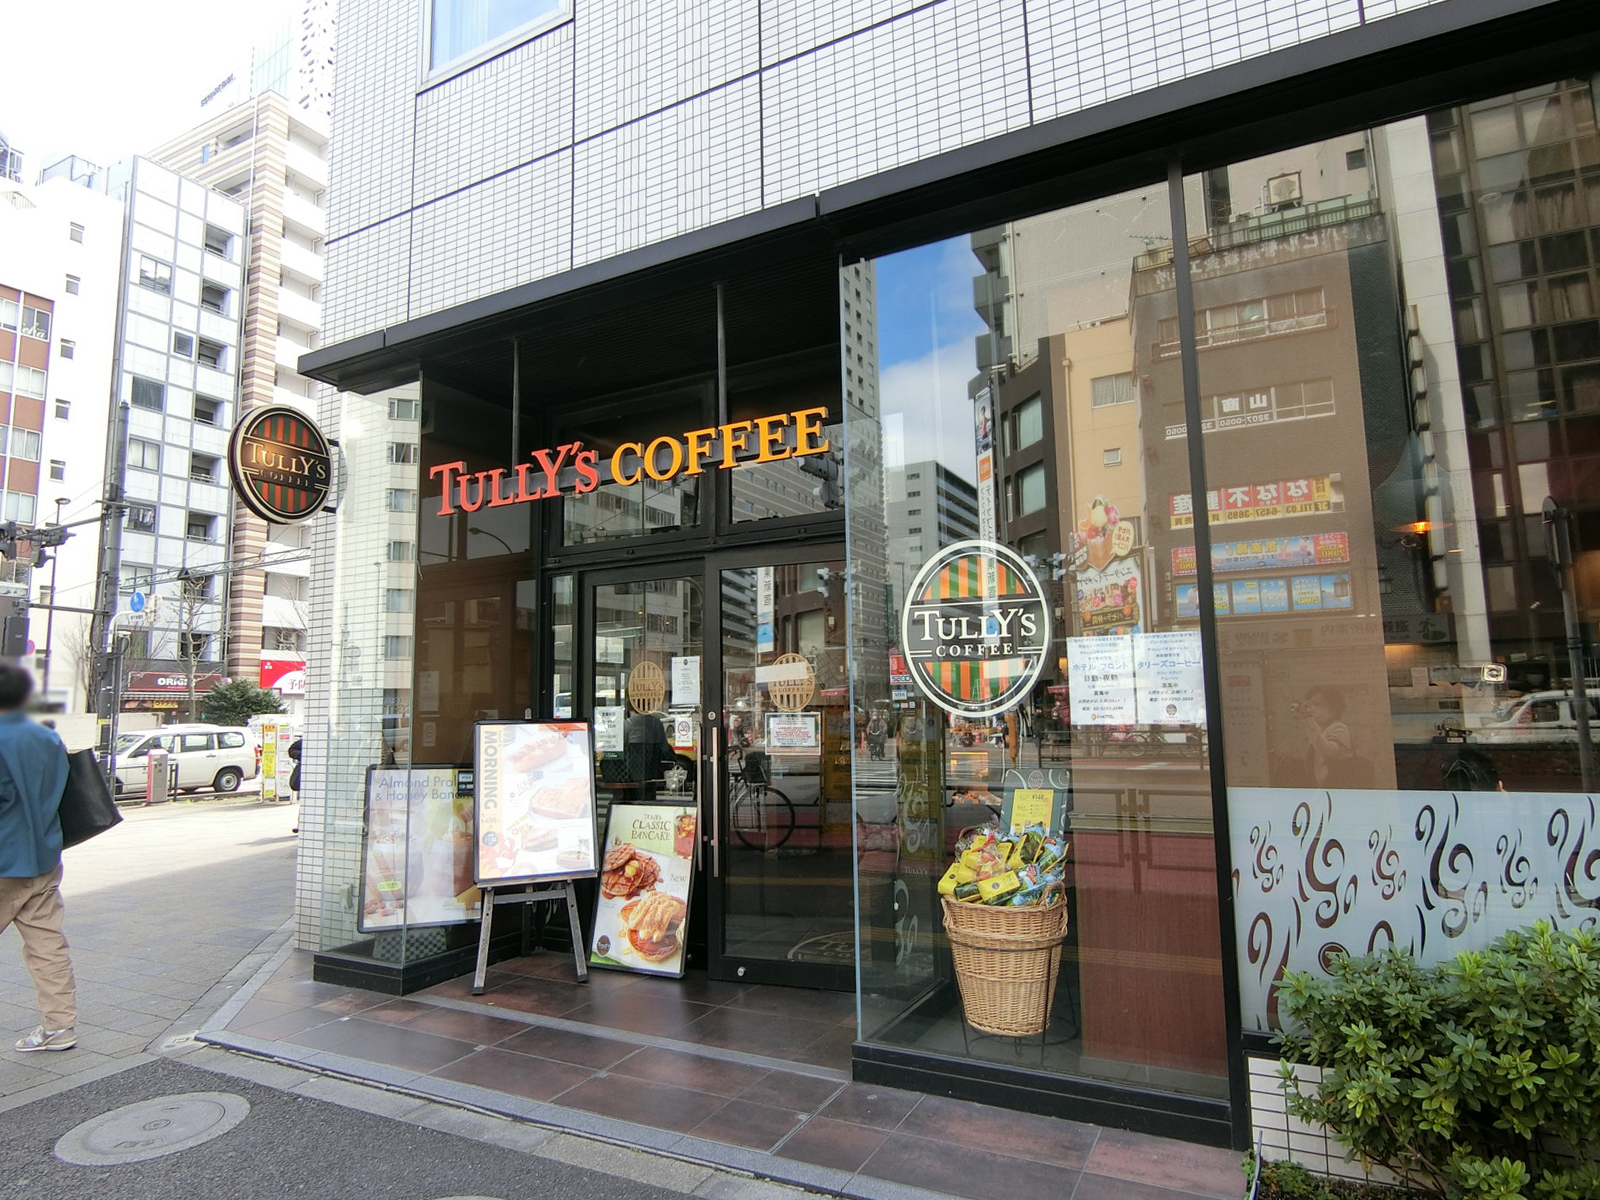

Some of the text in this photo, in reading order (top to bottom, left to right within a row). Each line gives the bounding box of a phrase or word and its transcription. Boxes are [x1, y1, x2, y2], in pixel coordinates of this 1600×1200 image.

[244, 441, 326, 480] TULLY'S
[429, 406, 830, 517] TULLY'S COFFEE
[259, 468, 311, 488] COFFEE
[914, 608, 1037, 642] TULLY'S
[935, 643, 1014, 658] COFFEE
[484, 730, 498, 810] MORNING
[378, 774, 457, 789] Almond Pral
[386, 789, 428, 804] Honey
[632, 819, 672, 832] CLASSIC
[630, 830, 671, 841] PANCAKE
